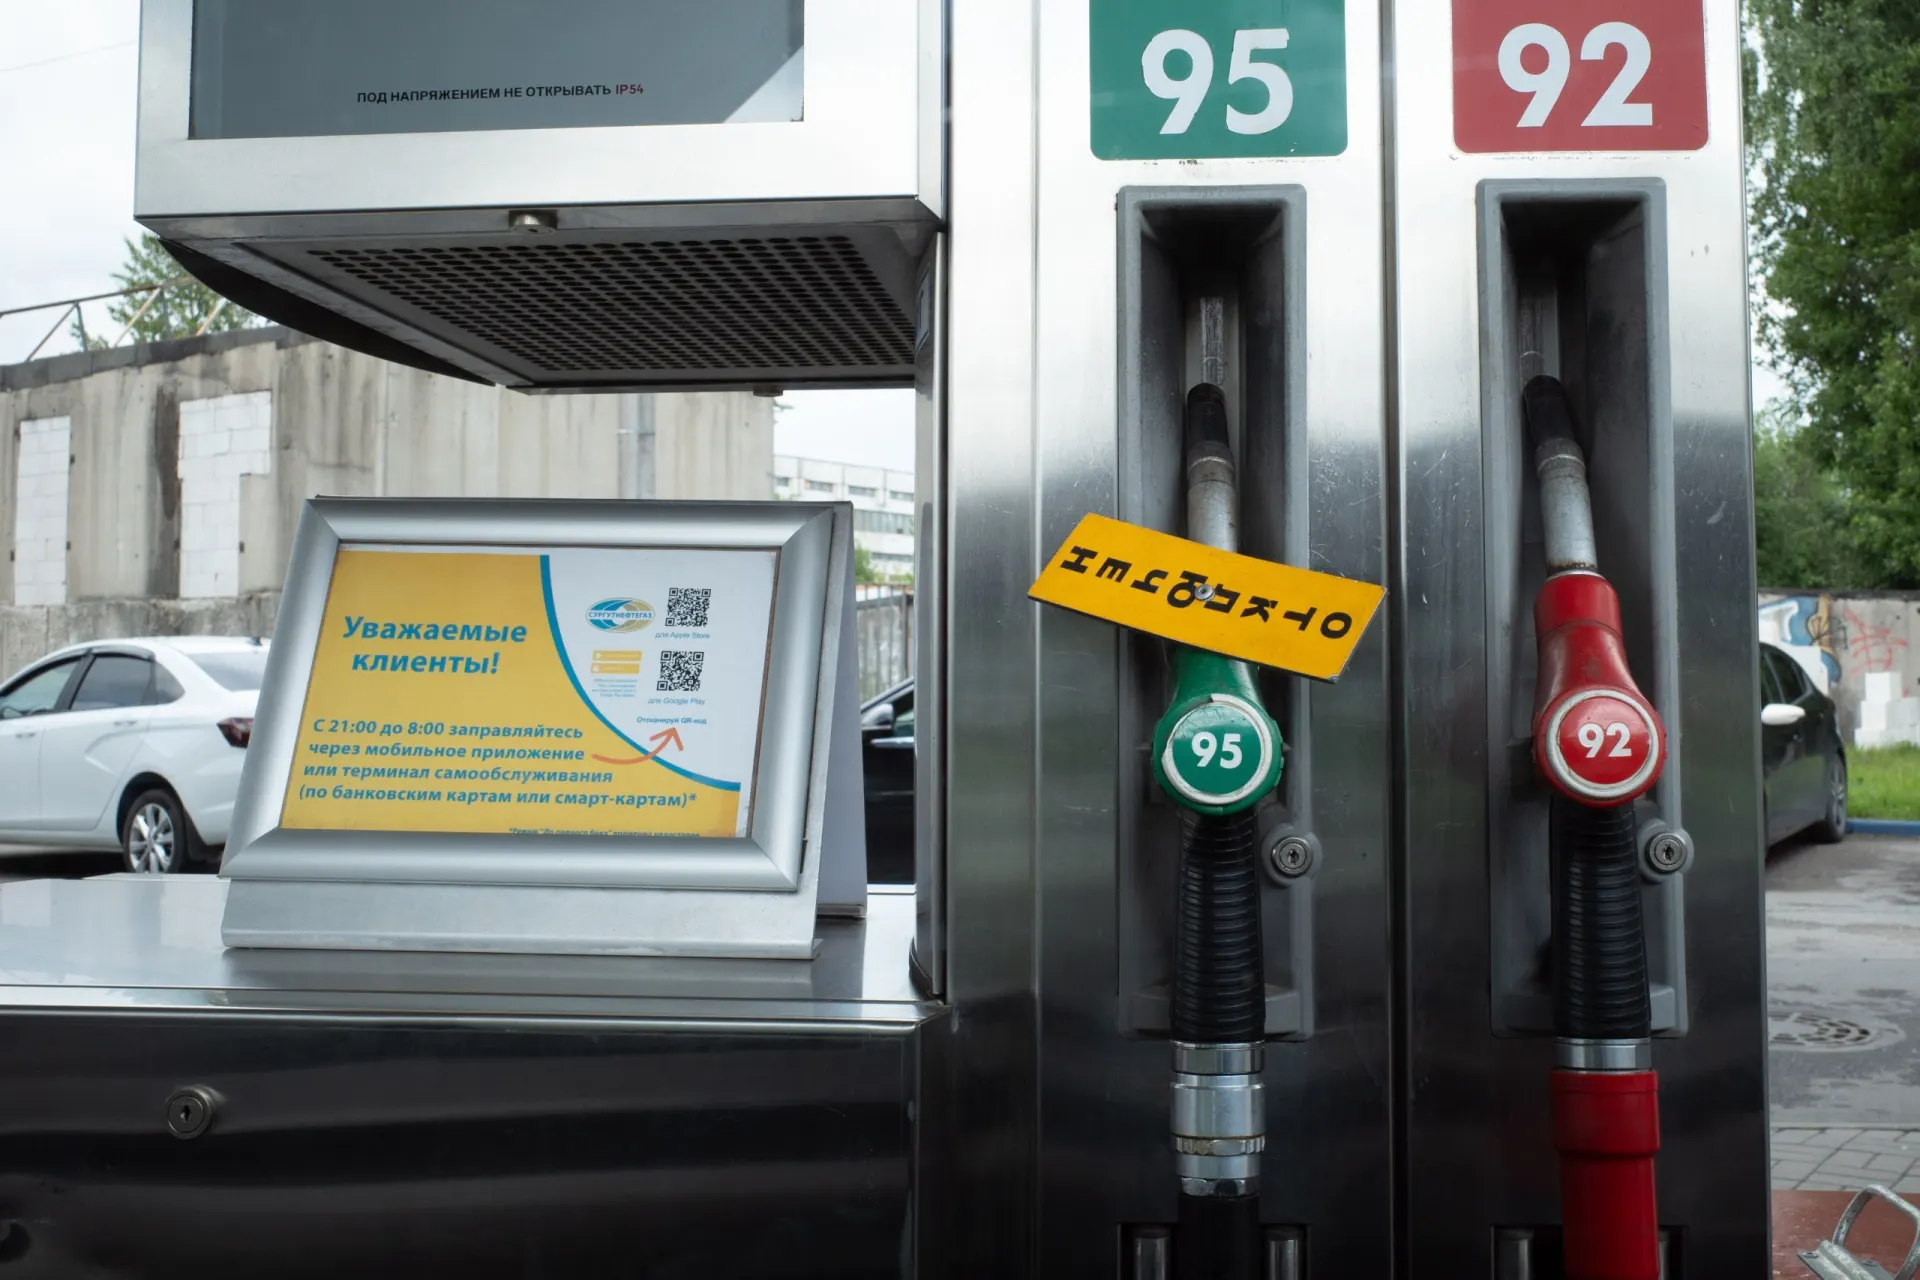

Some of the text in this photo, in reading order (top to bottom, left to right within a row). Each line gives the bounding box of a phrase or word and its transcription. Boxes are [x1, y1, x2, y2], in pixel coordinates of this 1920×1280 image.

[1141, 28, 1294, 135] 95
[1498, 21, 1653, 128] 92
[357, 83, 644, 104] ПОД НАПРЯЖЕНИЕМ НЕ ОТКРЫВАТЬ IP54
[1060, 545, 1353, 640] ОТКЛЮЧЕН
[588, 611, 653, 619] СУРГУТНЕФТЕГАЗ
[343, 616, 527, 642] Уважаемые
[671, 632, 690, 640] Apple
[352, 652, 500, 674] клиенты!
[663, 697, 689, 706] Google
[690, 697, 706, 705] Play
[313, 719, 583, 740] С 21:00 до 8:00 заправляйтесь
[1191, 731, 1243, 769] 95
[1578, 722, 1632, 759] 92
[309, 742, 585, 761] через мобильное приложение
[303, 765, 613, 785] или терминал самообслуживания
[299, 785, 327, 801] (по
[332, 784, 442, 801] банковским
[446, 790, 511, 805] картам
[516, 793, 549, 804] или
